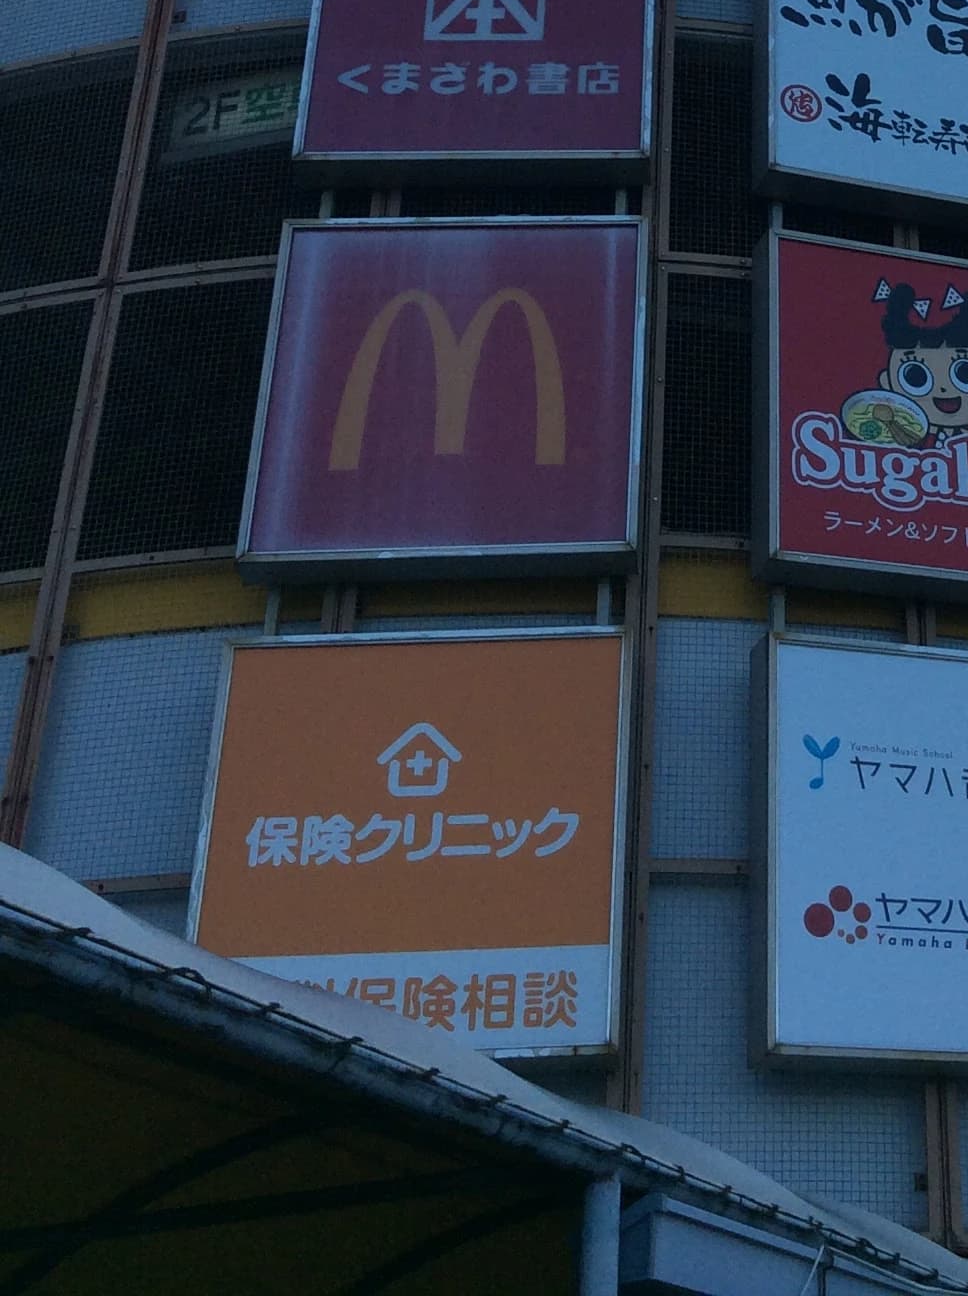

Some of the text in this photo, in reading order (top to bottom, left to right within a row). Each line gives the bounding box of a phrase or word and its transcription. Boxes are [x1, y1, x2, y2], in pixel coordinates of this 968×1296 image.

[337, 61, 619, 96] くまざわ書店
[246, 807, 579, 868] 保険クリニック
[877, 933, 953, 950] Yamaha
